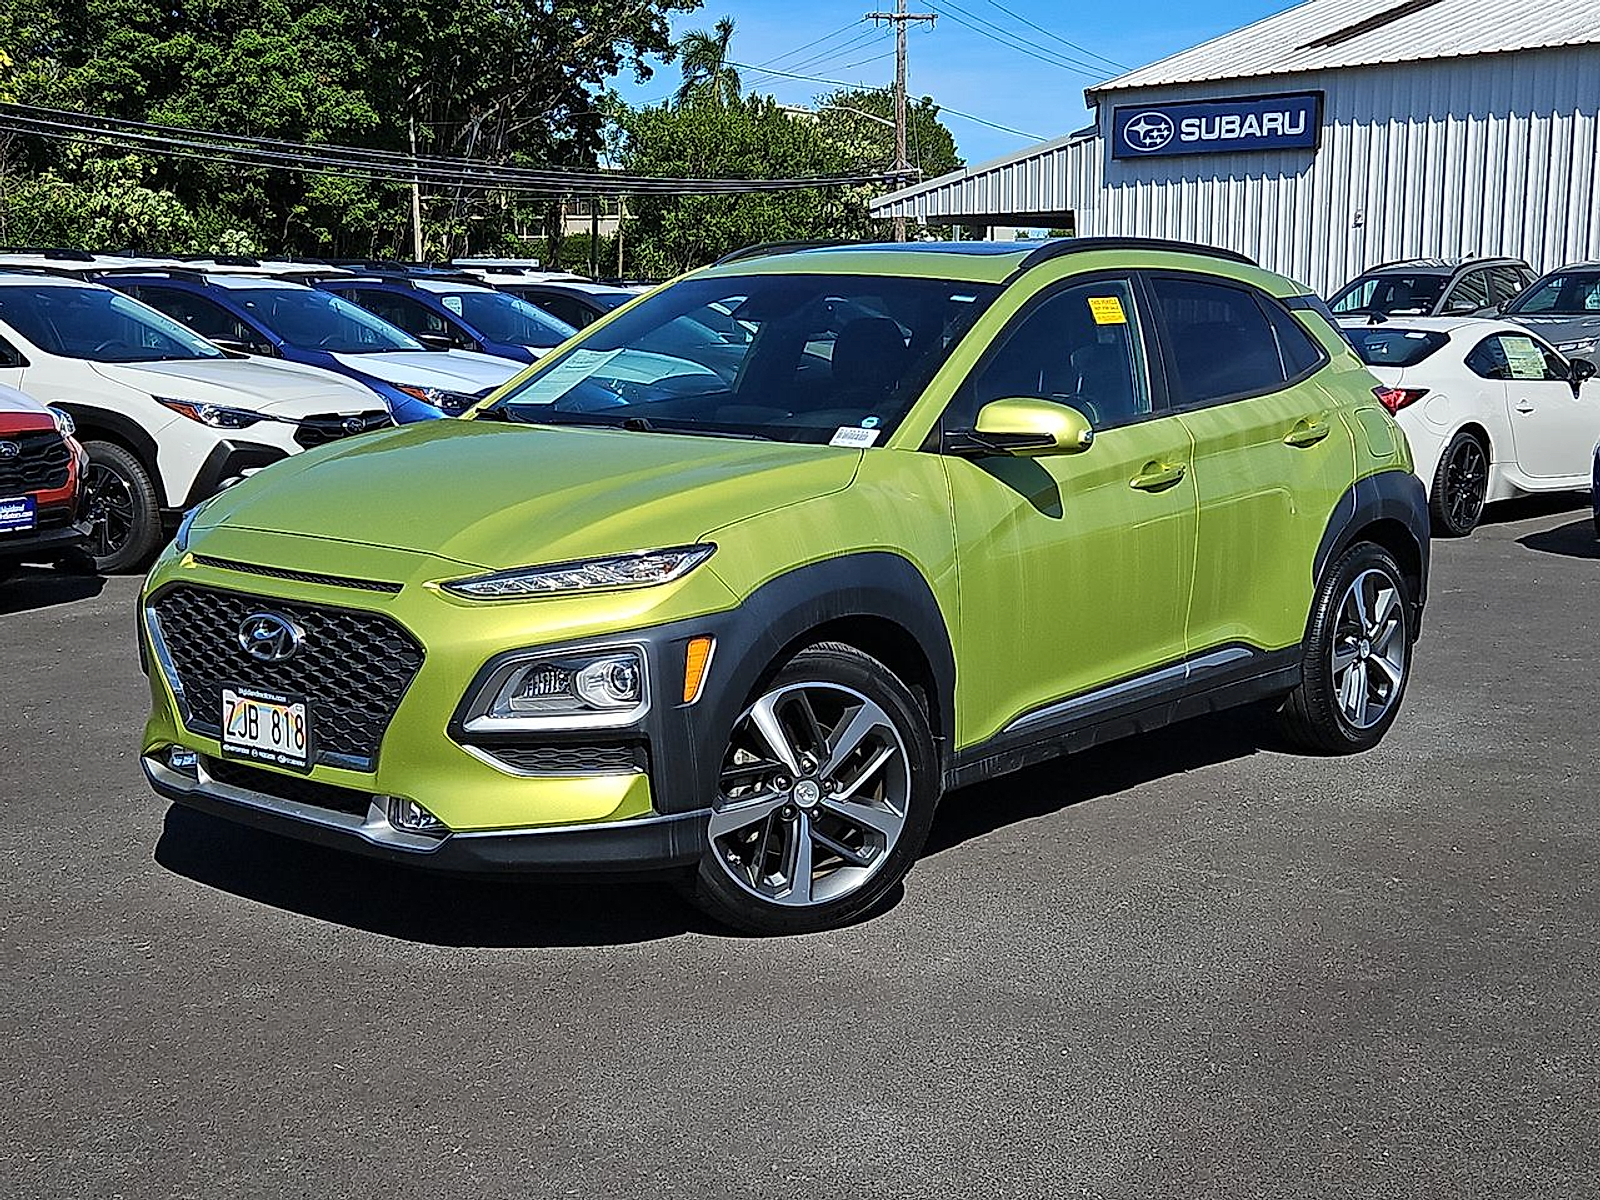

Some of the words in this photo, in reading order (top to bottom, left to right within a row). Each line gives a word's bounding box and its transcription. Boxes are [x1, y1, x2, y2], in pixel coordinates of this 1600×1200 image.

[1181, 110, 1306, 142] SUBARU
[226, 700, 258, 740] ZJB
[271, 709, 304, 750] 818
